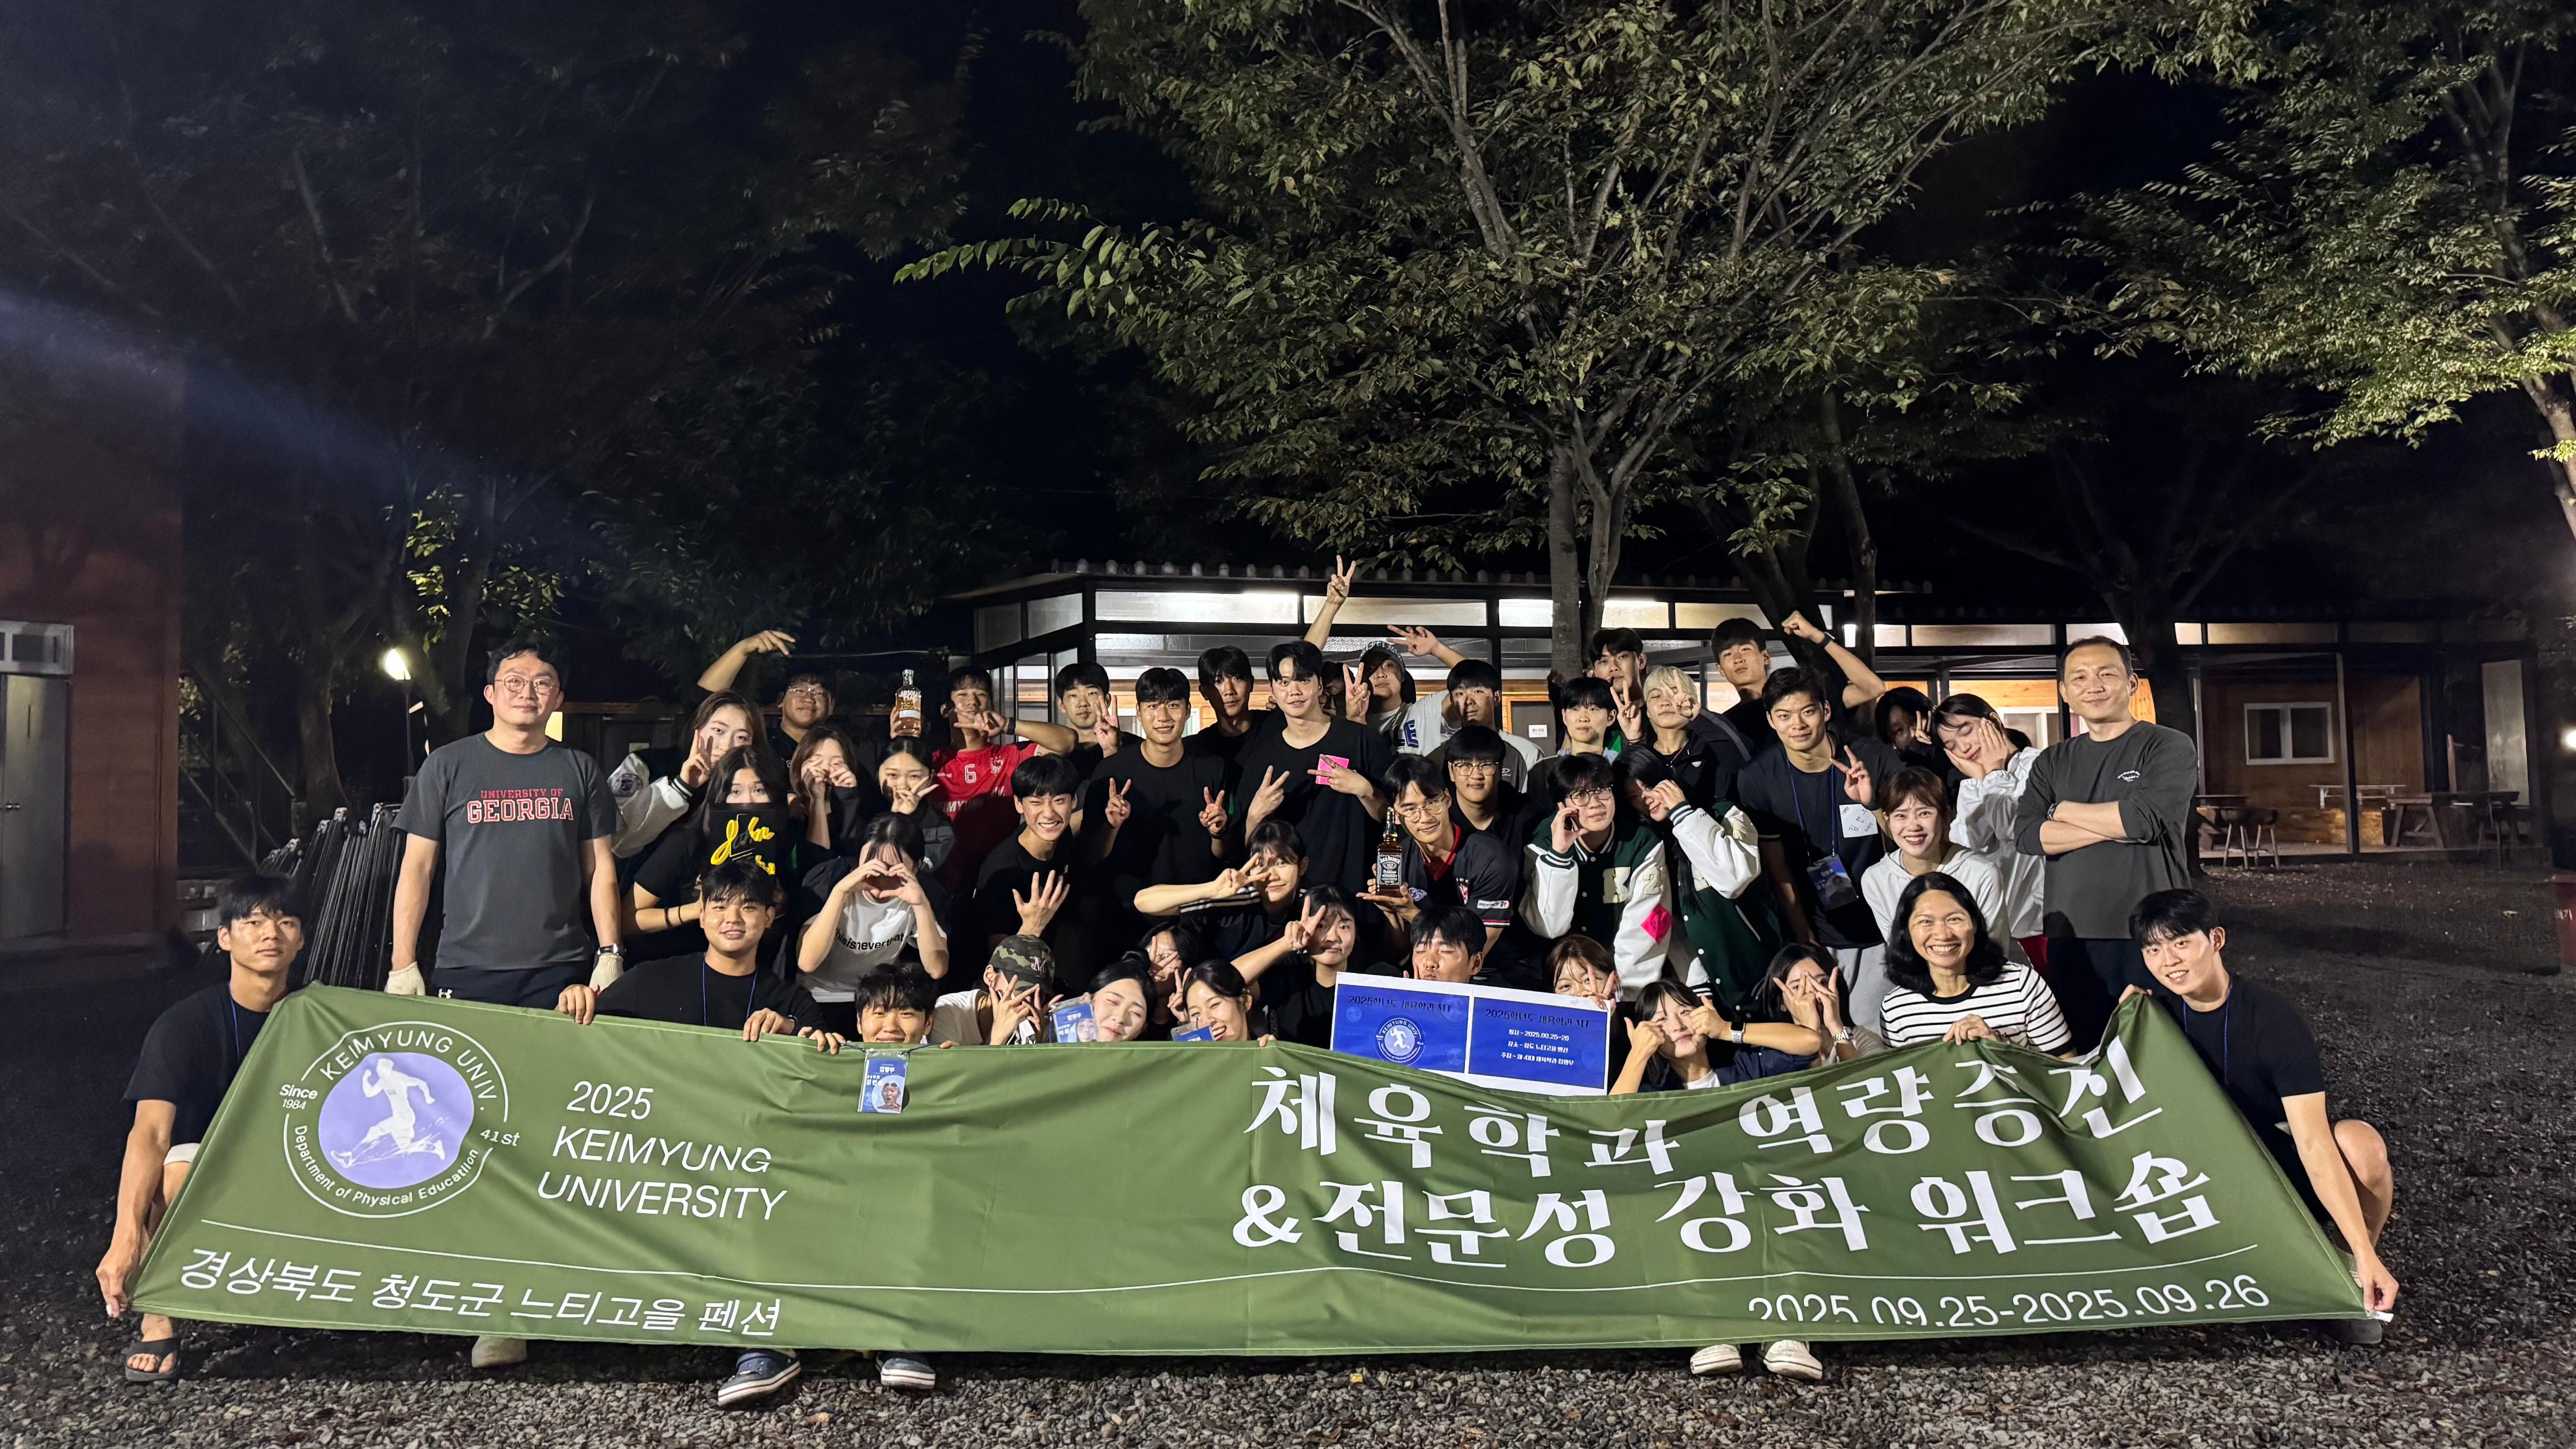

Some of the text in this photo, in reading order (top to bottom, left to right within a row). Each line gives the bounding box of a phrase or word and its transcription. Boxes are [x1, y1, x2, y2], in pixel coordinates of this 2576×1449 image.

[481, 788, 563, 799] UNIVERSITY OF
[964, 764, 977, 784] 6
[467, 797, 574, 823] GEORGIA
[280, 1084, 317, 1100] Since
[320, 1030, 497, 1111] KEIMYUNG UNIV.
[282, 1099, 306, 1110] 1984
[566, 1081, 654, 1120] 2025
[1244, 1035, 2163, 1177] 체육학과 역량증진
[480, 1129, 520, 1146] 41st
[552, 1126, 772, 1173] KEIMYUNG
[294, 1125, 336, 1191] Department
[335, 1186, 352, 1198] of
[353, 1191, 413, 1207] Physical
[538, 1171, 787, 1220] UNIVERSITY
[1653, 1172, 1870, 1253] 강화
[1910, 1151, 2222, 1255] 워크숍
[181, 1249, 781, 1336] 경상북도 청도군 느티고을 펜션
